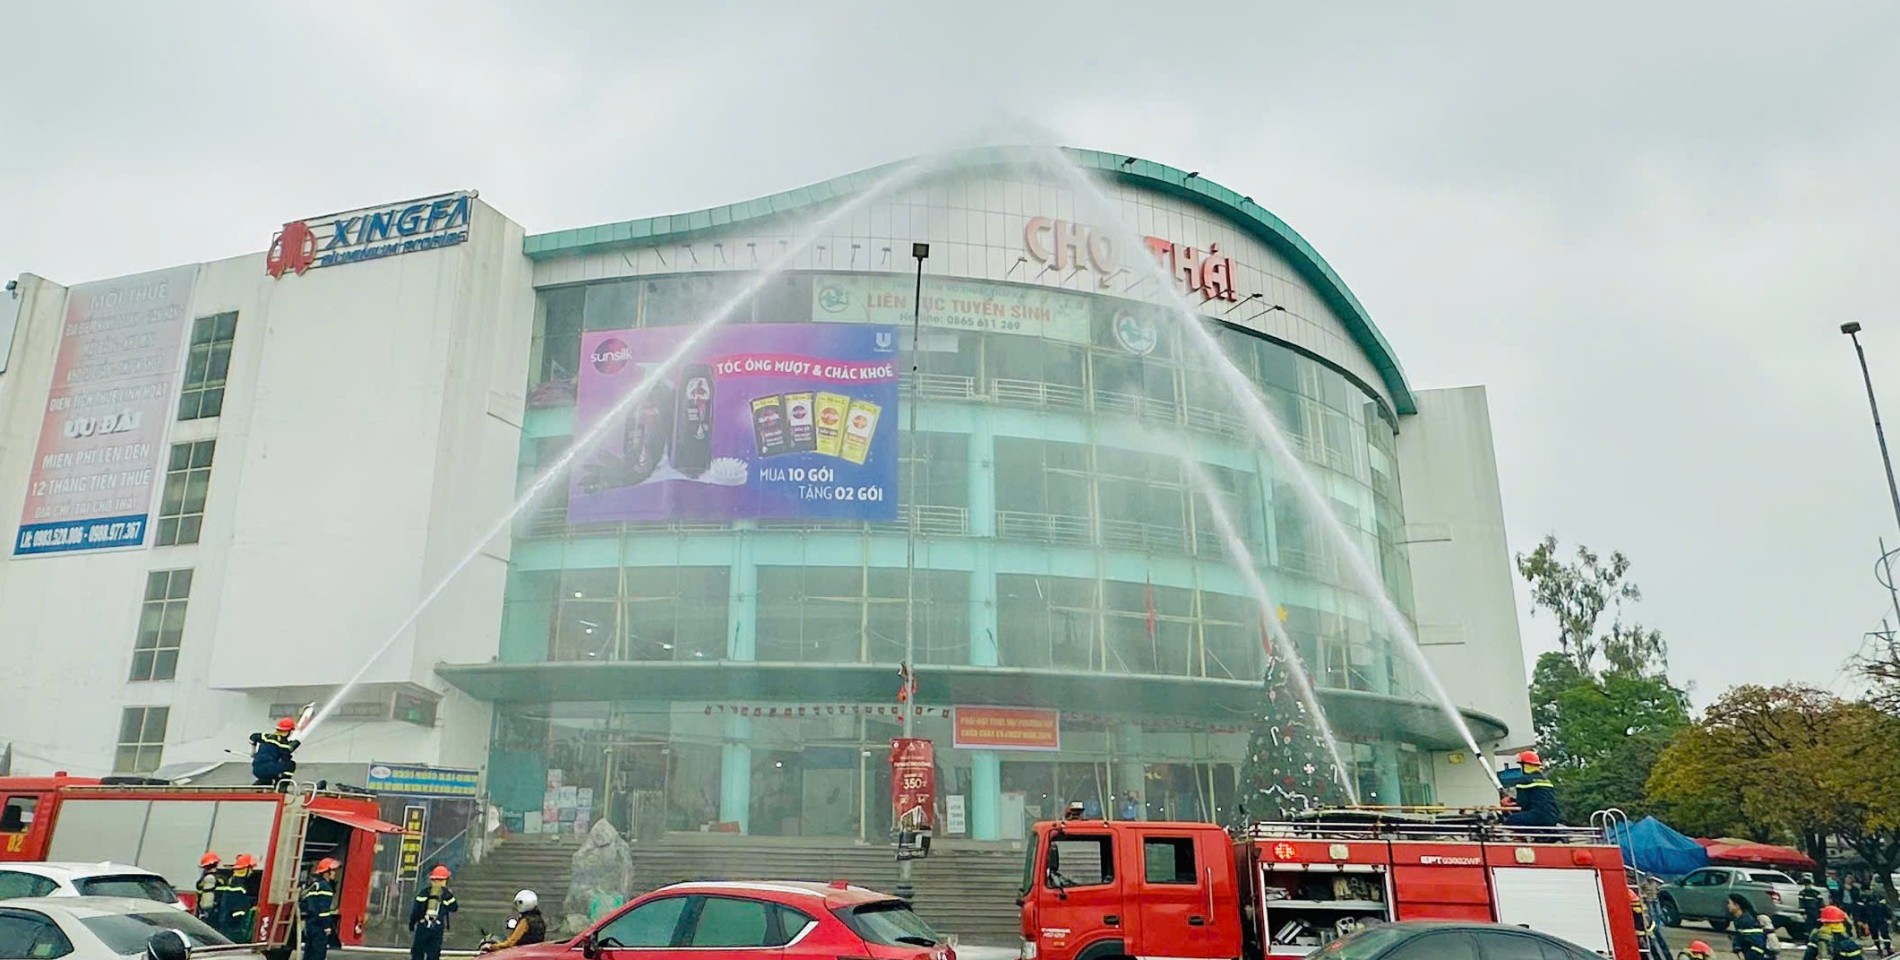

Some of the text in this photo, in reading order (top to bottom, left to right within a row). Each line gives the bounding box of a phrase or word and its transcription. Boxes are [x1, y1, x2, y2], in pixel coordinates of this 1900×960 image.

[325, 195, 469, 250] XINGFA
[867, 292, 906, 309] LIÊN
[1010, 303, 1051, 321] SINH
[590, 347, 633, 363] sunsilk
[717, 360, 741, 375] TÓC
[775, 361, 811, 376] MƯỢT
[813, 364, 822, 376] &
[760, 465, 834, 482] MUA 10 GÓI
[31, 482, 46, 496] 12
[798, 484, 883, 502] TẶNG 02 GÓI
[903, 778, 922, 790] 350
